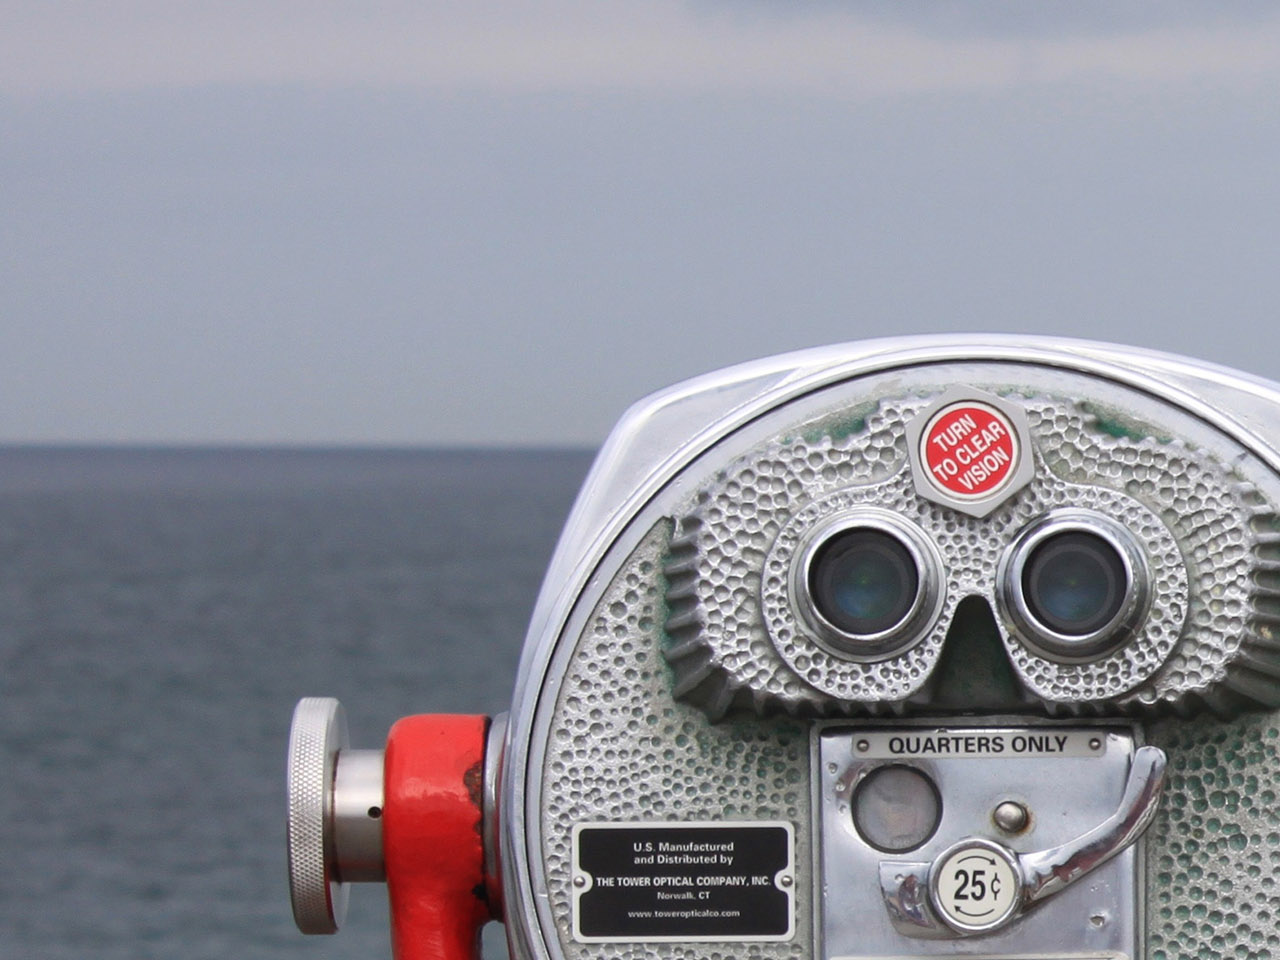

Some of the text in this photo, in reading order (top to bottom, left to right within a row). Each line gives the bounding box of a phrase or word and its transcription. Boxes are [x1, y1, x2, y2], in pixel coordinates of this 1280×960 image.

[933, 414, 977, 452] TURN
[933, 421, 1006, 481] TO CLEAR
[958, 446, 1010, 490] VISION
[889, 735, 1069, 755] QUARTERS ONLY
[634, 842, 734, 852] U.S. Manufactured
[634, 855, 734, 866] and Distributed by
[596, 876, 771, 887] THE TOWER OPTICAL COMPANY, INC.
[699, 891, 710, 900] CT
[628, 910, 740, 919] www.toweropticalco.com
